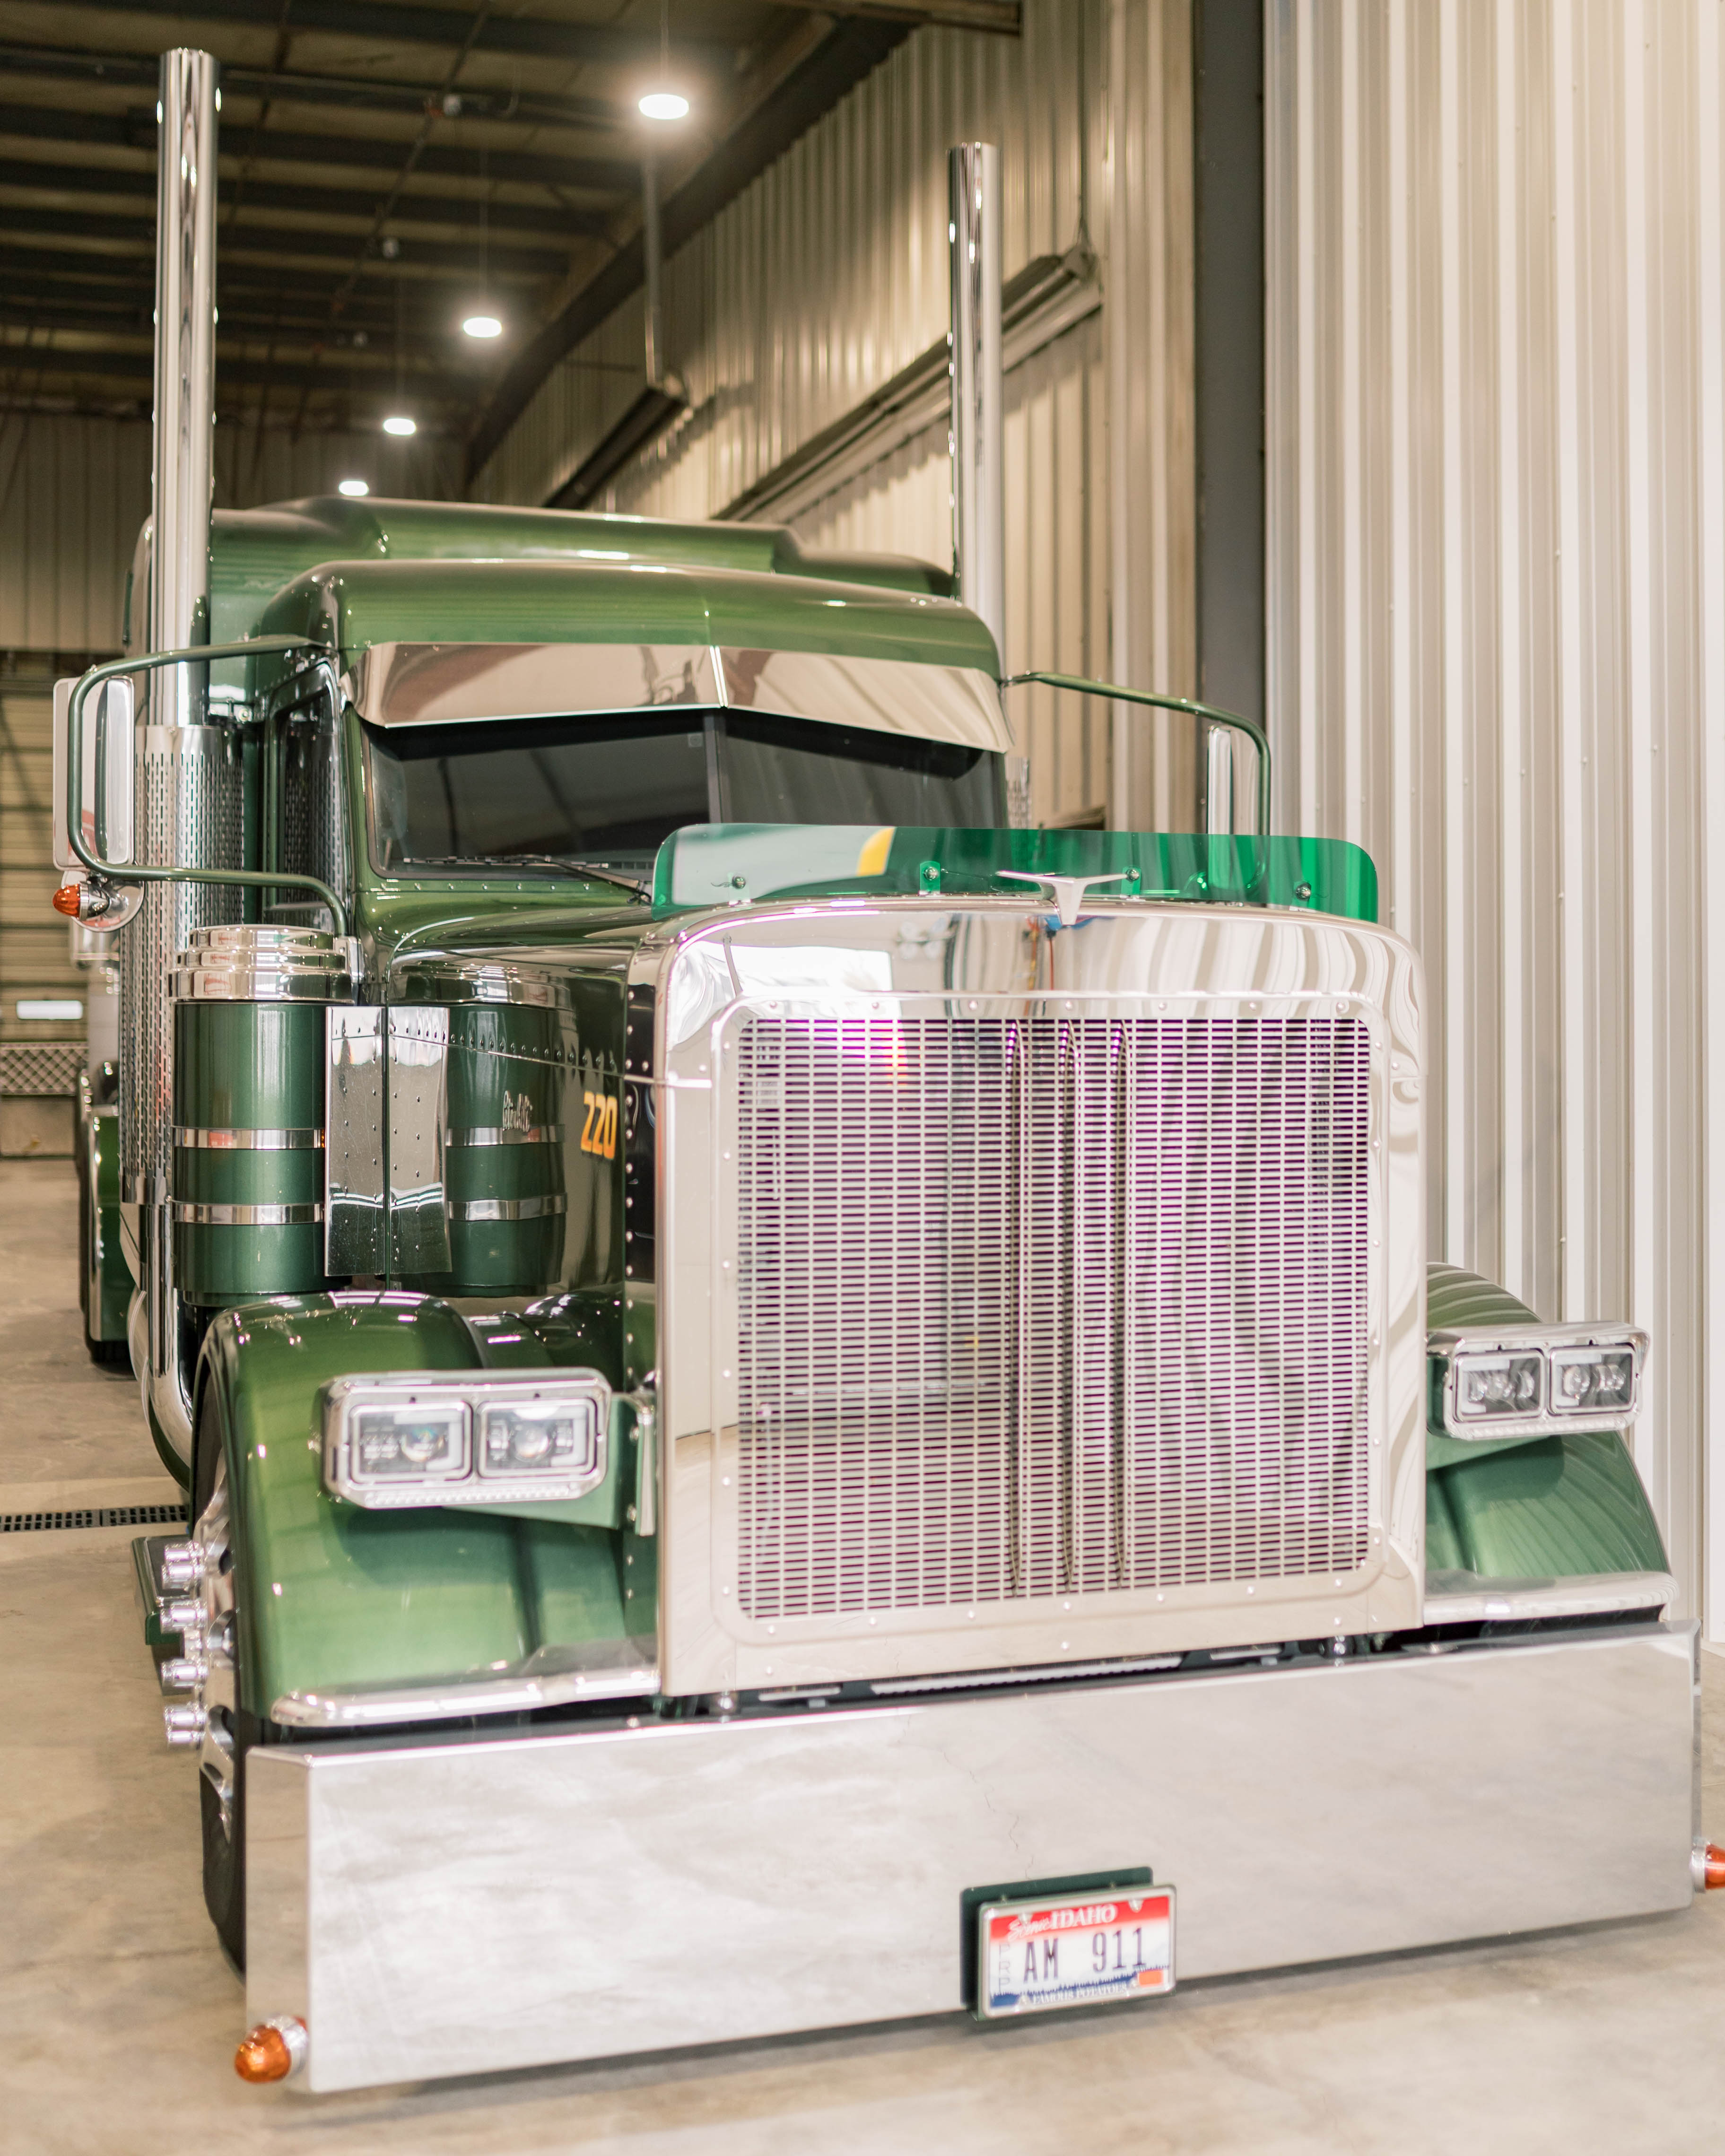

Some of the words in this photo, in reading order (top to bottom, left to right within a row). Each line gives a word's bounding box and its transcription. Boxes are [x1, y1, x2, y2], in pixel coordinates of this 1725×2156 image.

[581, 1091, 618, 1159] 220
[1050, 1904, 1118, 1930] IDAHO
[1023, 1938, 1059, 1983] AM
[1092, 1928, 1146, 1973] 911
[1032, 1991, 1074, 2005] FAMOUS
[1076, 1982, 1128, 2000] POTATOES
